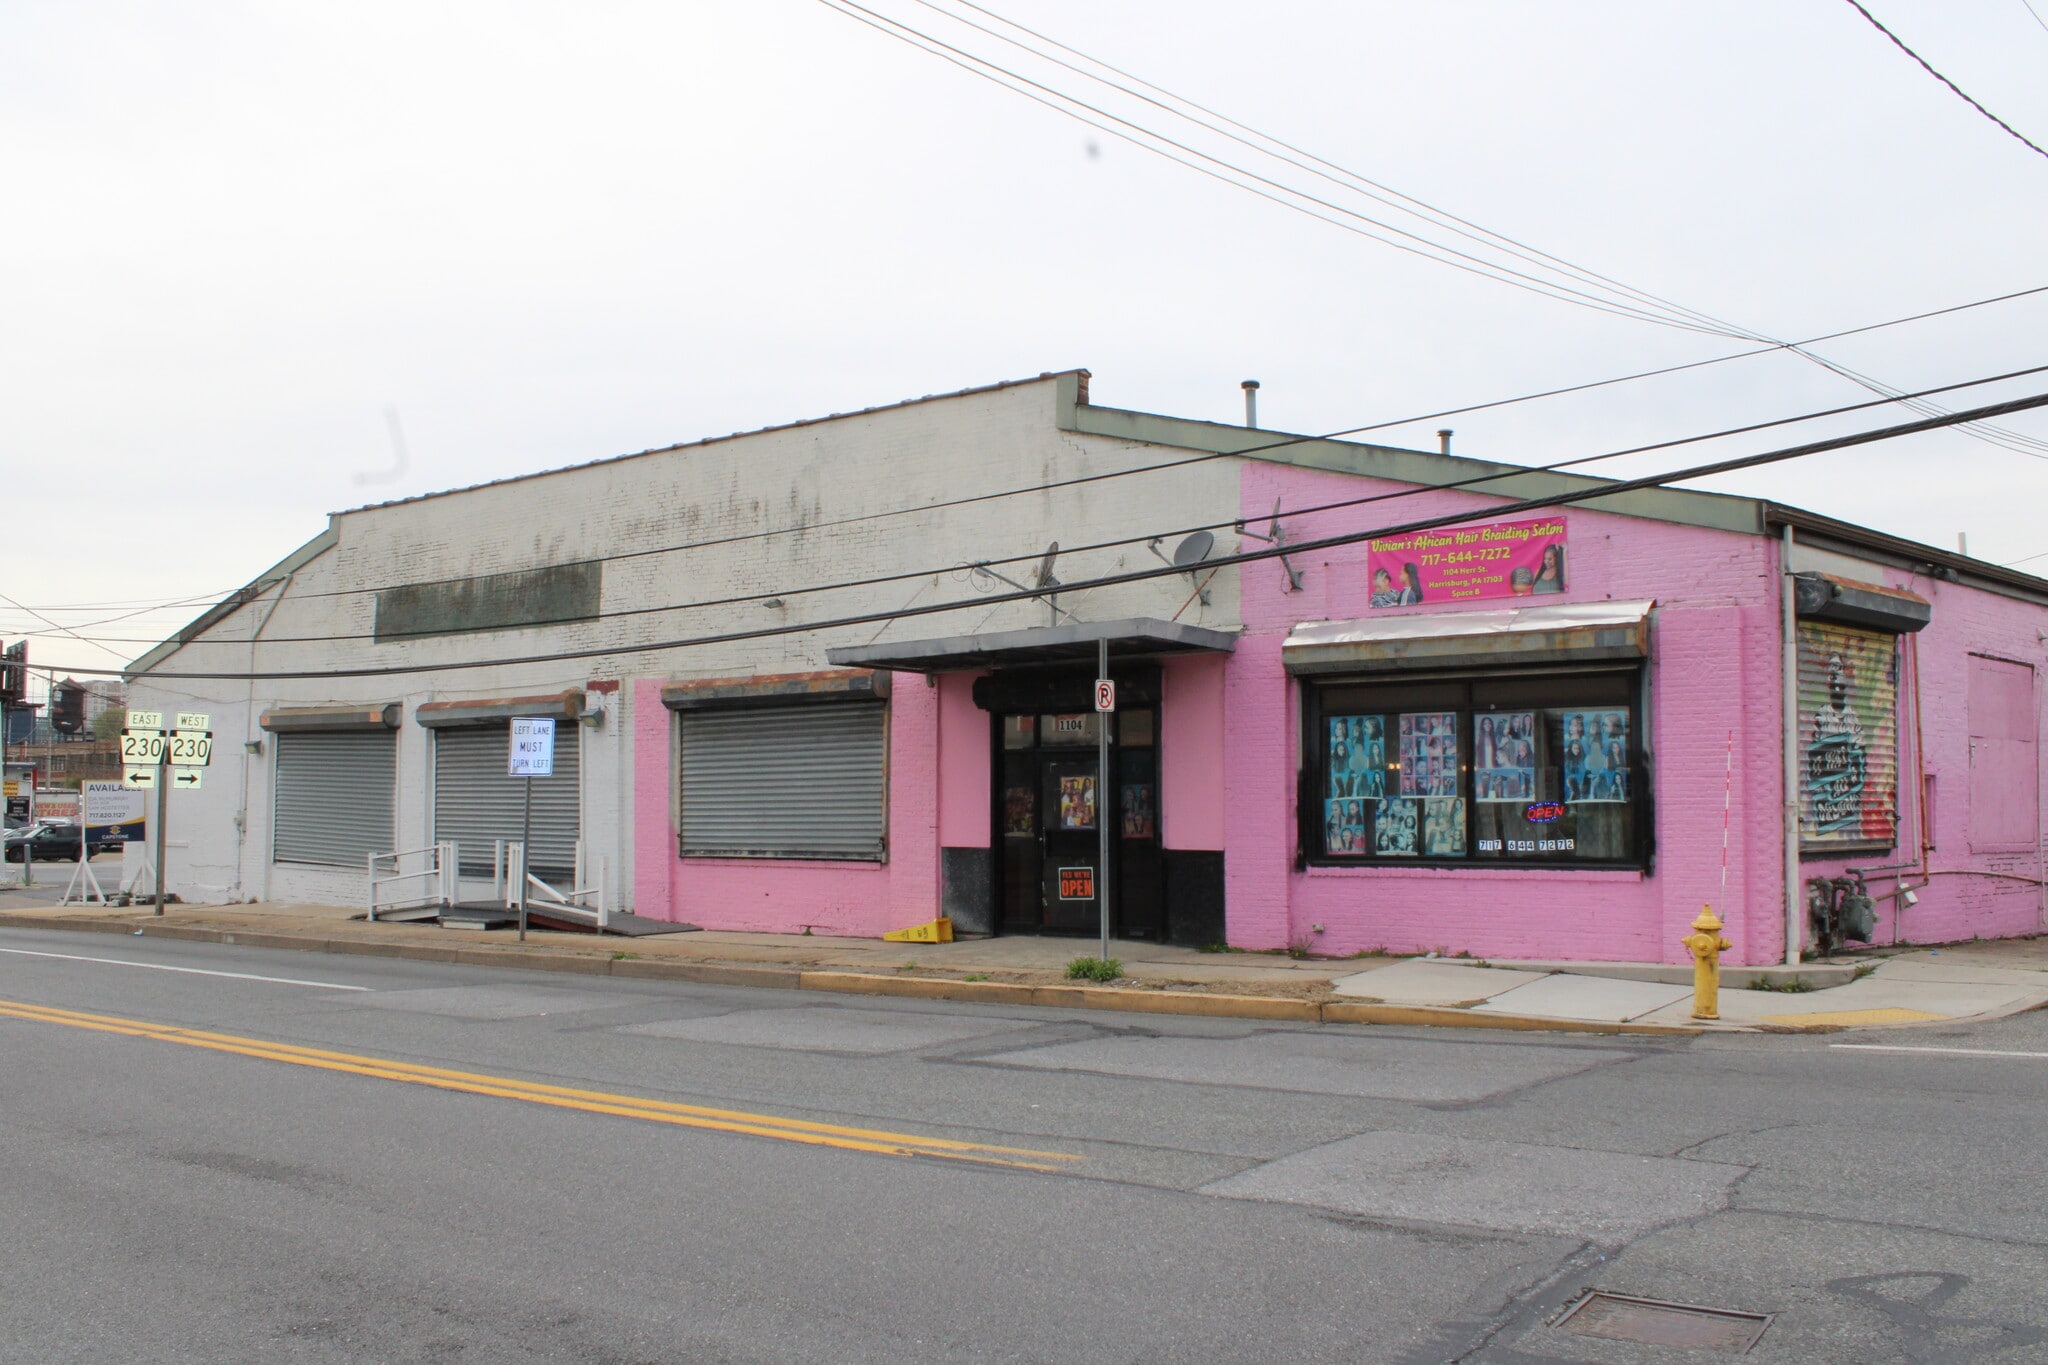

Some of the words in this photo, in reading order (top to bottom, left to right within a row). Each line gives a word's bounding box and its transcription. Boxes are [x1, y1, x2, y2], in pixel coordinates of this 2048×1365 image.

[1372, 537, 1411, 552] Vivian's
[1414, 534, 1452, 550] African
[1456, 531, 1478, 545] Hair
[1482, 526, 1529, 542] Braiding
[1532, 522, 1564, 537] Salon
[1421, 546, 1511, 566] 717-644-7272
[1477, 565, 1488, 573] St.
[1429, 579, 1470, 588] Harrisburg,
[1451, 590, 1474, 598] Space
[132, 714, 158, 725] EAST
[181, 716, 206, 727] WEST
[1060, 720, 1082, 730] 1104
[514, 726, 530, 735] LEFT
[533, 726, 550, 735] LANE
[125, 737, 162, 757] 230
[173, 738, 208, 758] 230
[520, 741, 543, 752] MUST
[512, 759, 530, 768] TURN
[533, 759, 549, 768] LEFT
[88, 784, 143, 792] AVAILA
[38, 809, 77, 817] TIRES
[1527, 806, 1565, 819] OPEN
[1480, 840, 1502, 850] 717
[1508, 841, 1534, 850] 644
[1540, 839, 1574, 850] 7272
[1061, 880, 1092, 896] OPEN
